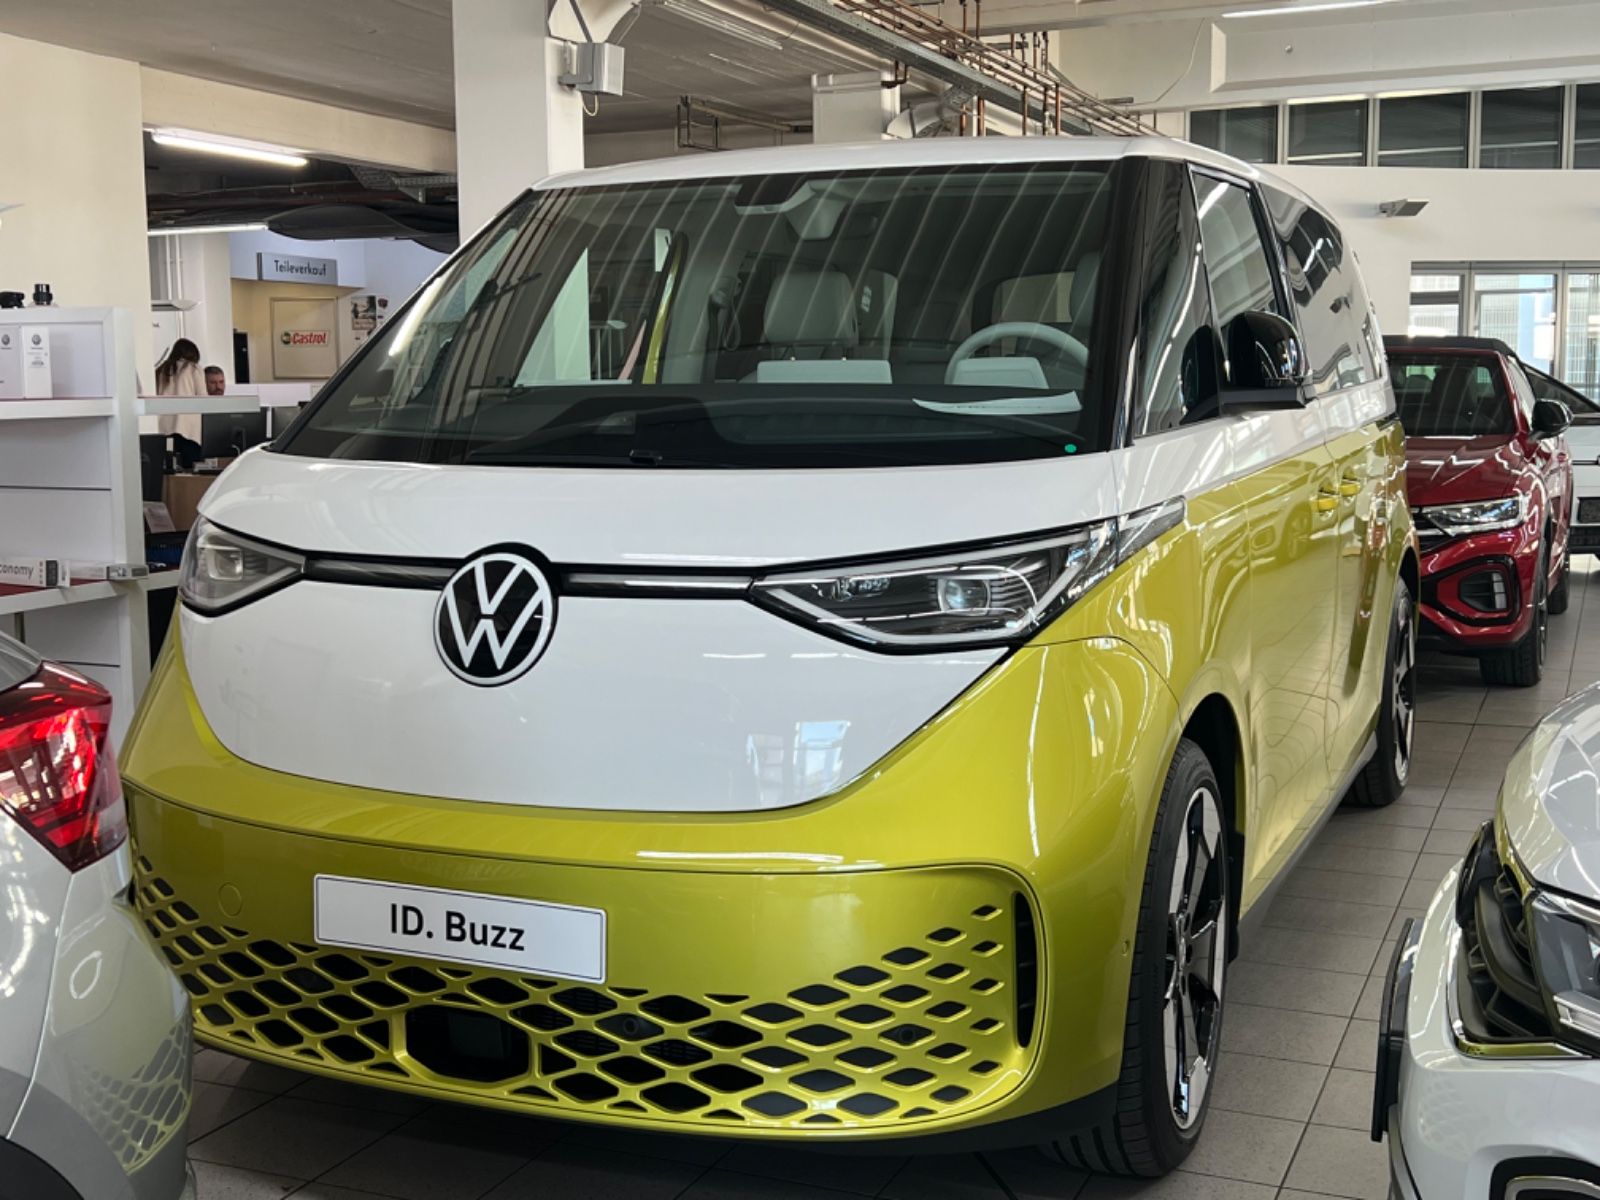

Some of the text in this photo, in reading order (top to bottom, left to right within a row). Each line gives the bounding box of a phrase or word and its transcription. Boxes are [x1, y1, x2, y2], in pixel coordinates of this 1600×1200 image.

[274, 259, 326, 276] Teileverkauf
[292, 332, 326, 345] Castrol
[390, 903, 525, 951] ID. Buzz
